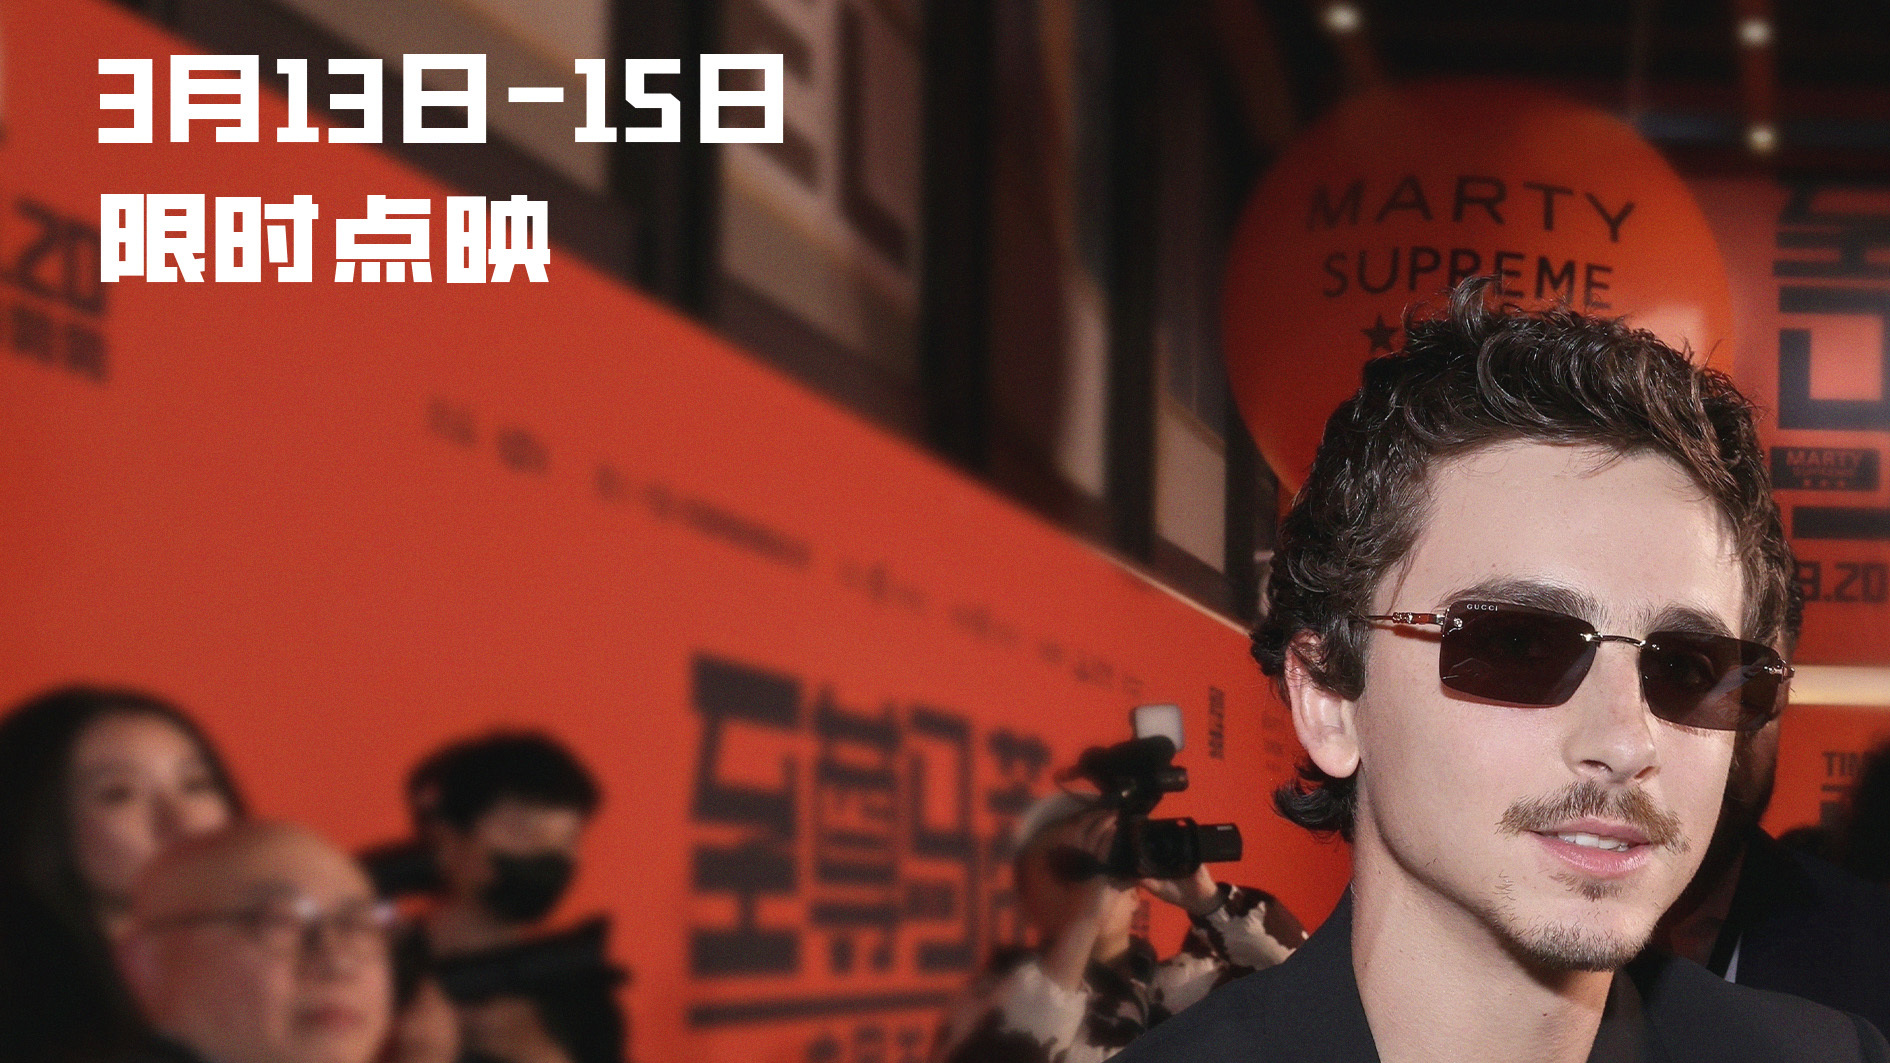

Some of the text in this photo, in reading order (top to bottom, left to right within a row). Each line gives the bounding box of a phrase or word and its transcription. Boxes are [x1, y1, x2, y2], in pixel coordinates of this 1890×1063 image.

[1307, 172, 1637, 244] MARTY
[1322, 245, 1614, 312] SUPREME
[1466, 603, 1498, 612] GUCCI
